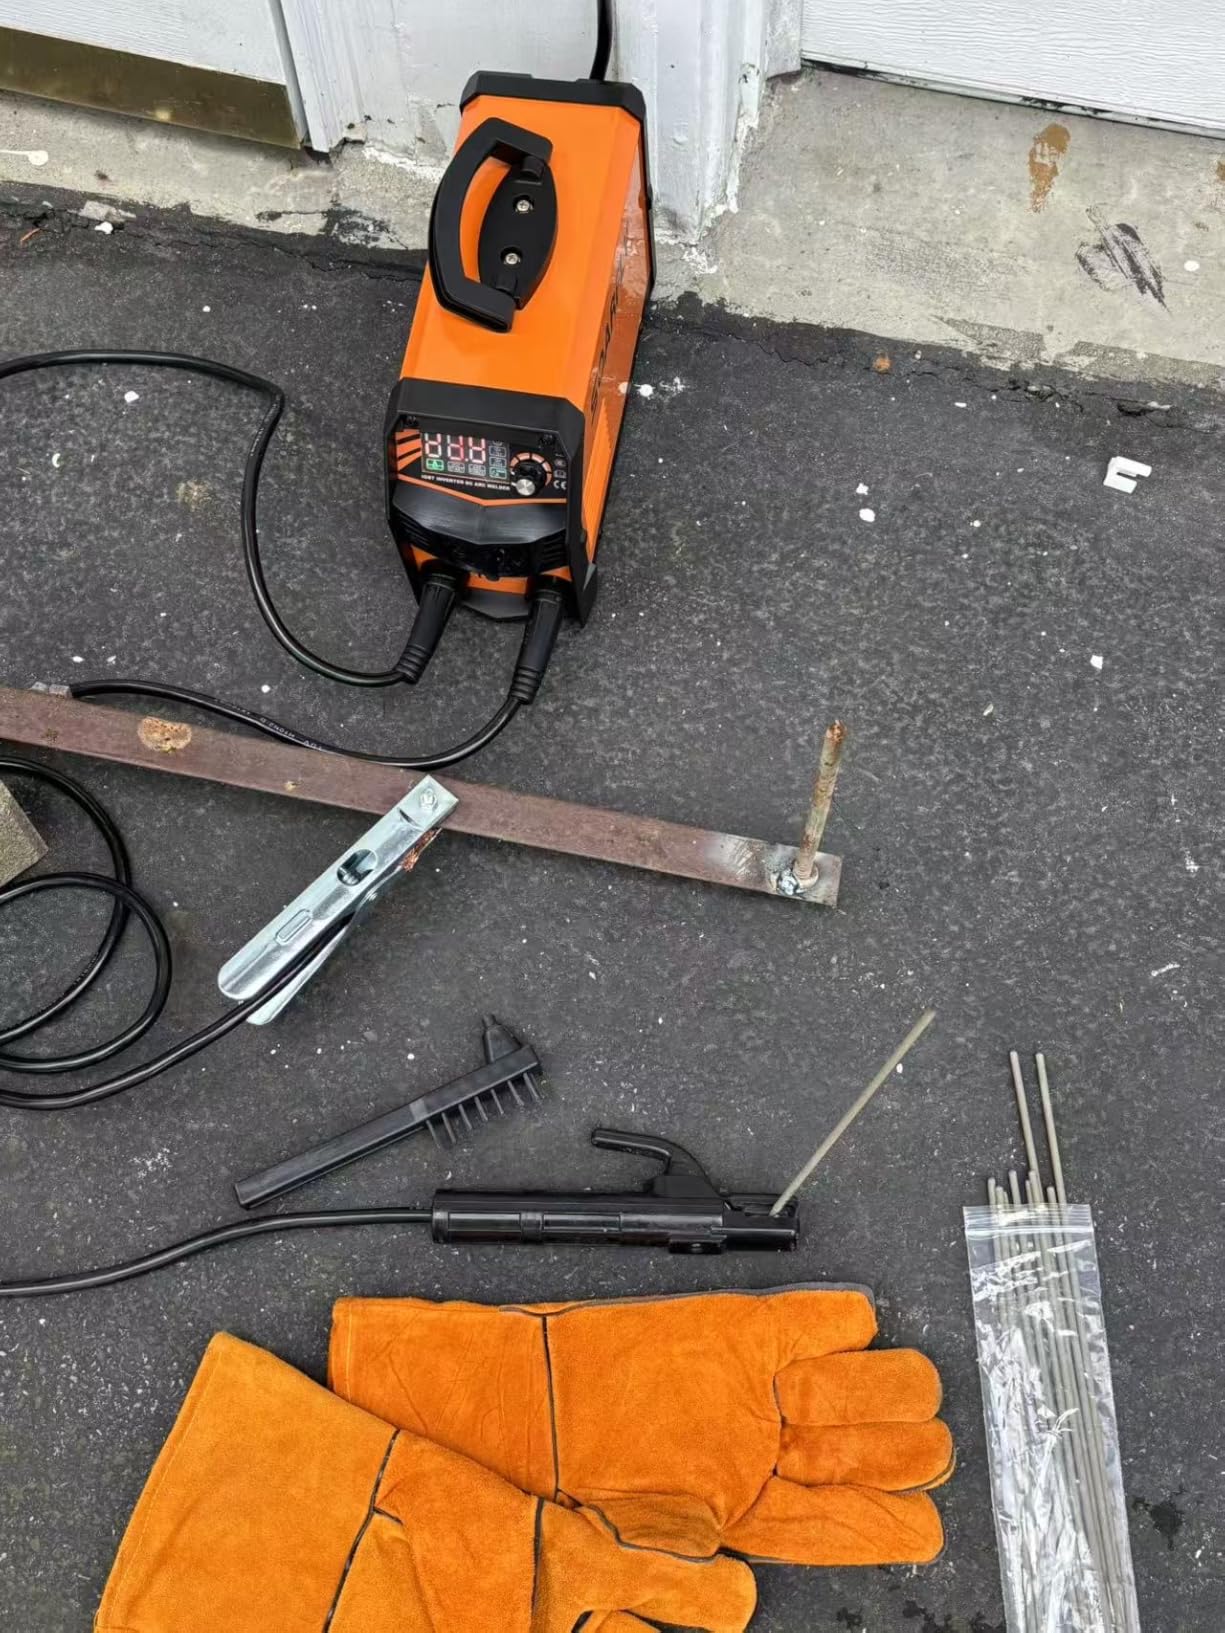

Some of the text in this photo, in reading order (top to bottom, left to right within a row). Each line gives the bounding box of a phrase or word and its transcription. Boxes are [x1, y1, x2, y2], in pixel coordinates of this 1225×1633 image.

[436, 476, 465, 485] INVERTER
[487, 483, 511, 491] WELDER
[553, 480, 567, 490] CE
